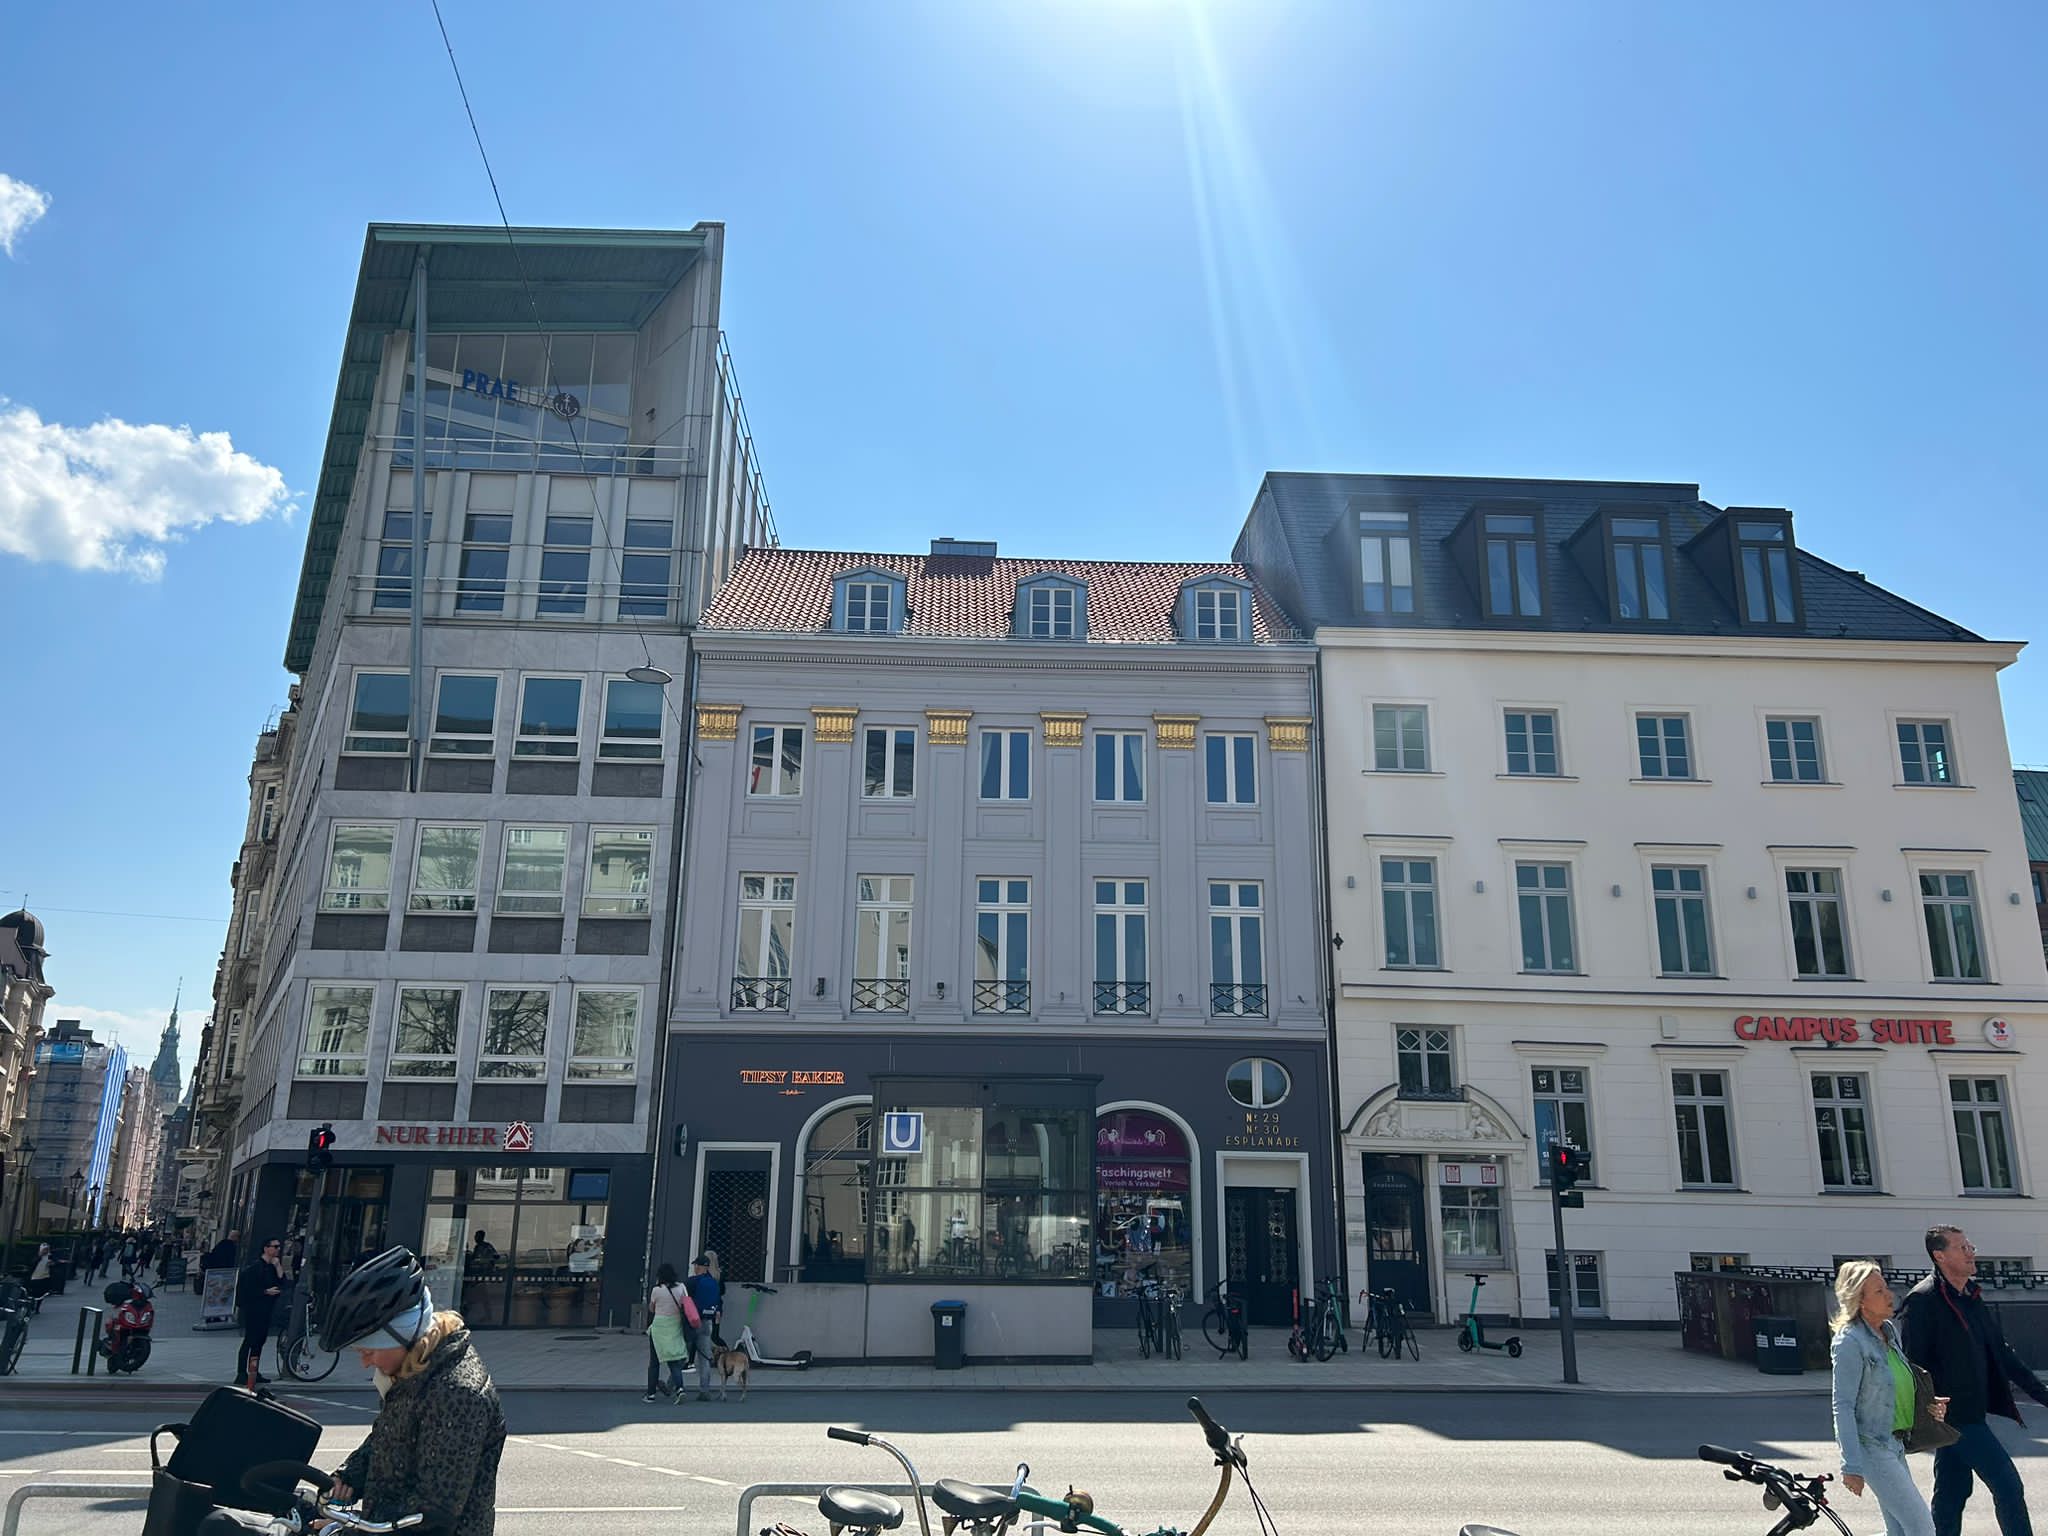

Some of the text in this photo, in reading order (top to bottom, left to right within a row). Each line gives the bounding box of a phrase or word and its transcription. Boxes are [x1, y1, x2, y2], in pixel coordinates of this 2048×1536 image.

[1734, 1015, 1956, 1045] CAMPUS SUITE
[740, 1070, 845, 1084] TIPSY BAKER
[1263, 1113, 1279, 1123] 29
[376, 1126, 497, 1146] NUR HIER
[891, 1116, 917, 1148] U
[1263, 1125, 1279, 1135] 30
[1225, 1135, 1299, 1146] ESPLANADE
